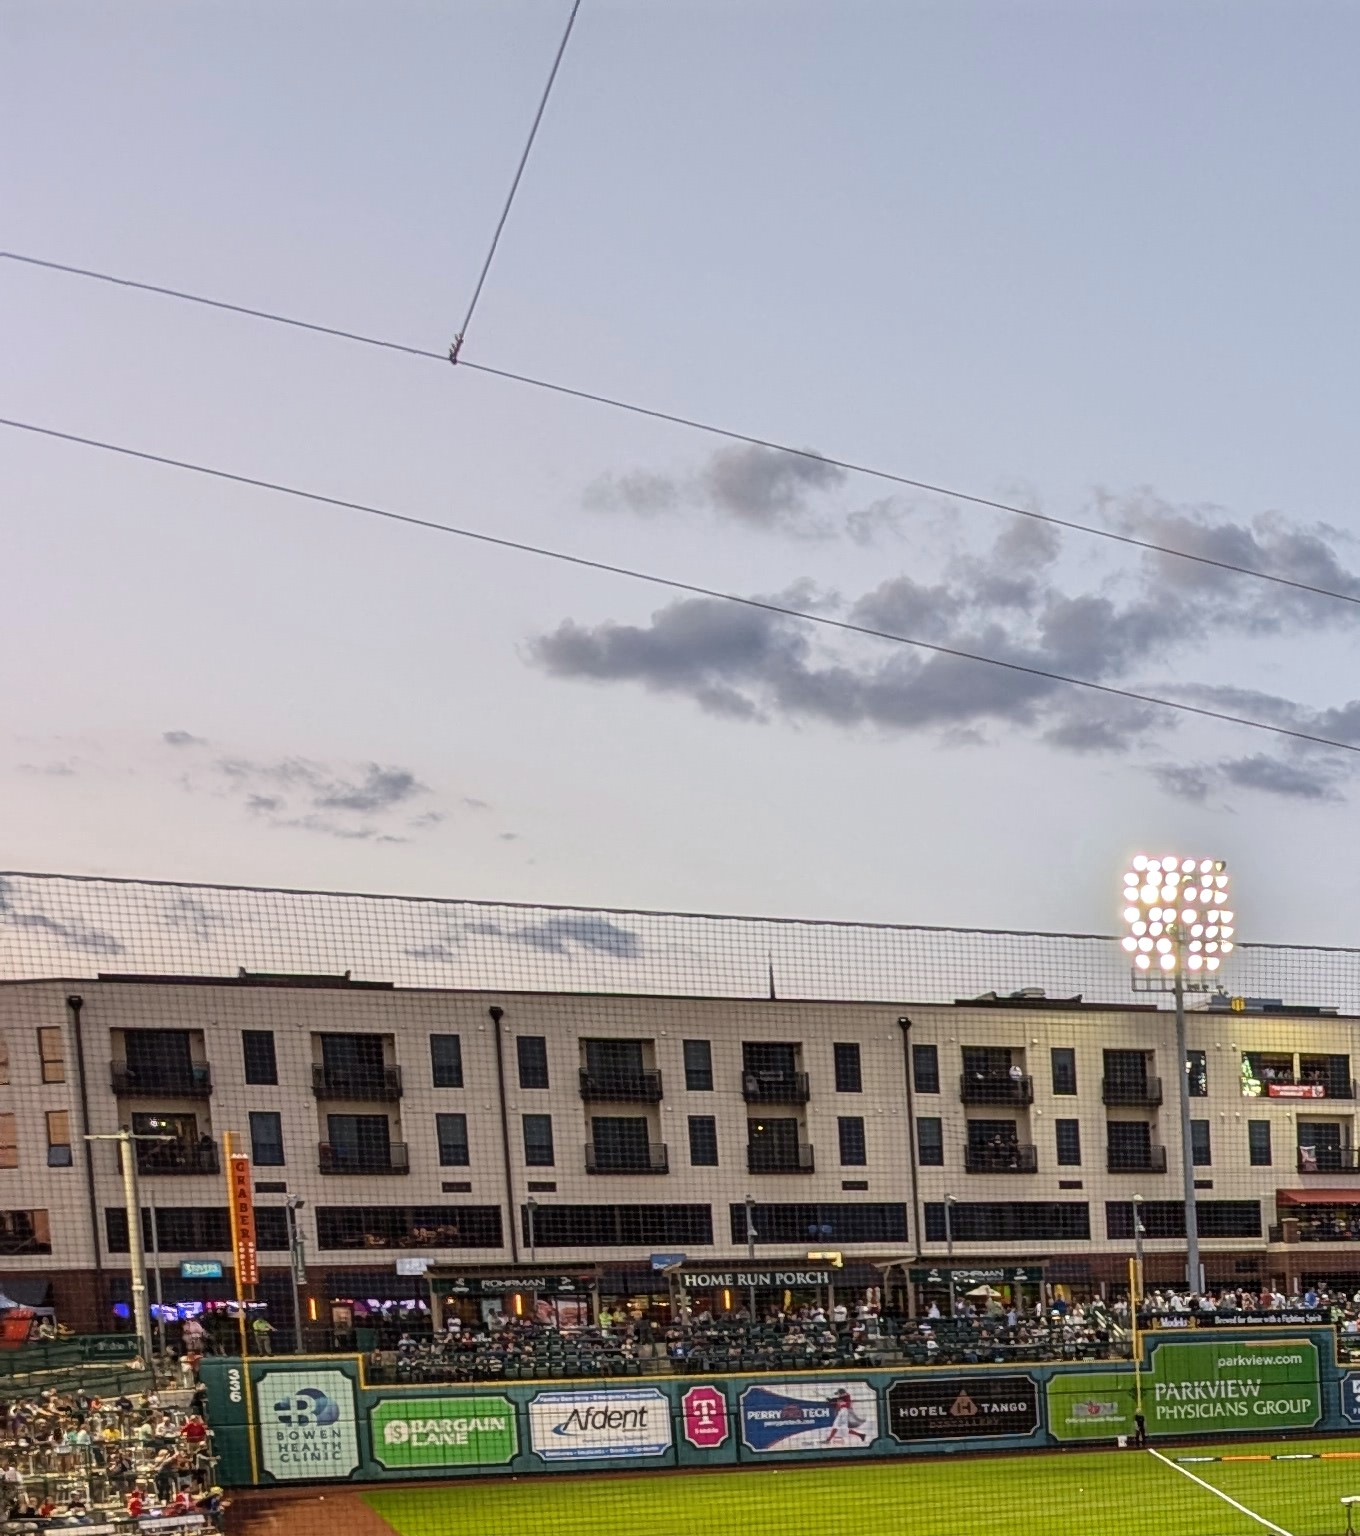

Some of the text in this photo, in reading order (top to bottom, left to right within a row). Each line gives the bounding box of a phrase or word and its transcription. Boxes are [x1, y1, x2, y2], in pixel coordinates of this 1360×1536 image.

[235, 1161, 250, 1239] GRABER
[685, 1271, 829, 1287] HOME RUN PORCH
[1217, 1353, 1303, 1368] parkview.com
[1155, 1378, 1261, 1401] PARKVIEW
[692, 1400, 716, 1425] T
[747, 1408, 830, 1420] PERRY TECH
[900, 1406, 947, 1417] HOTEL
[981, 1402, 1027, 1413] TANGO
[1156, 1399, 1311, 1421] PHYSICIANS GROUP
[410, 1417, 505, 1434] BARGAIN
[562, 1405, 648, 1431] Afdent
[276, 1429, 342, 1441] BOWEN
[411, 1431, 468, 1447] LANE
[277, 1441, 341, 1452] HEALTH
[280, 1451, 341, 1463] CLINIC
